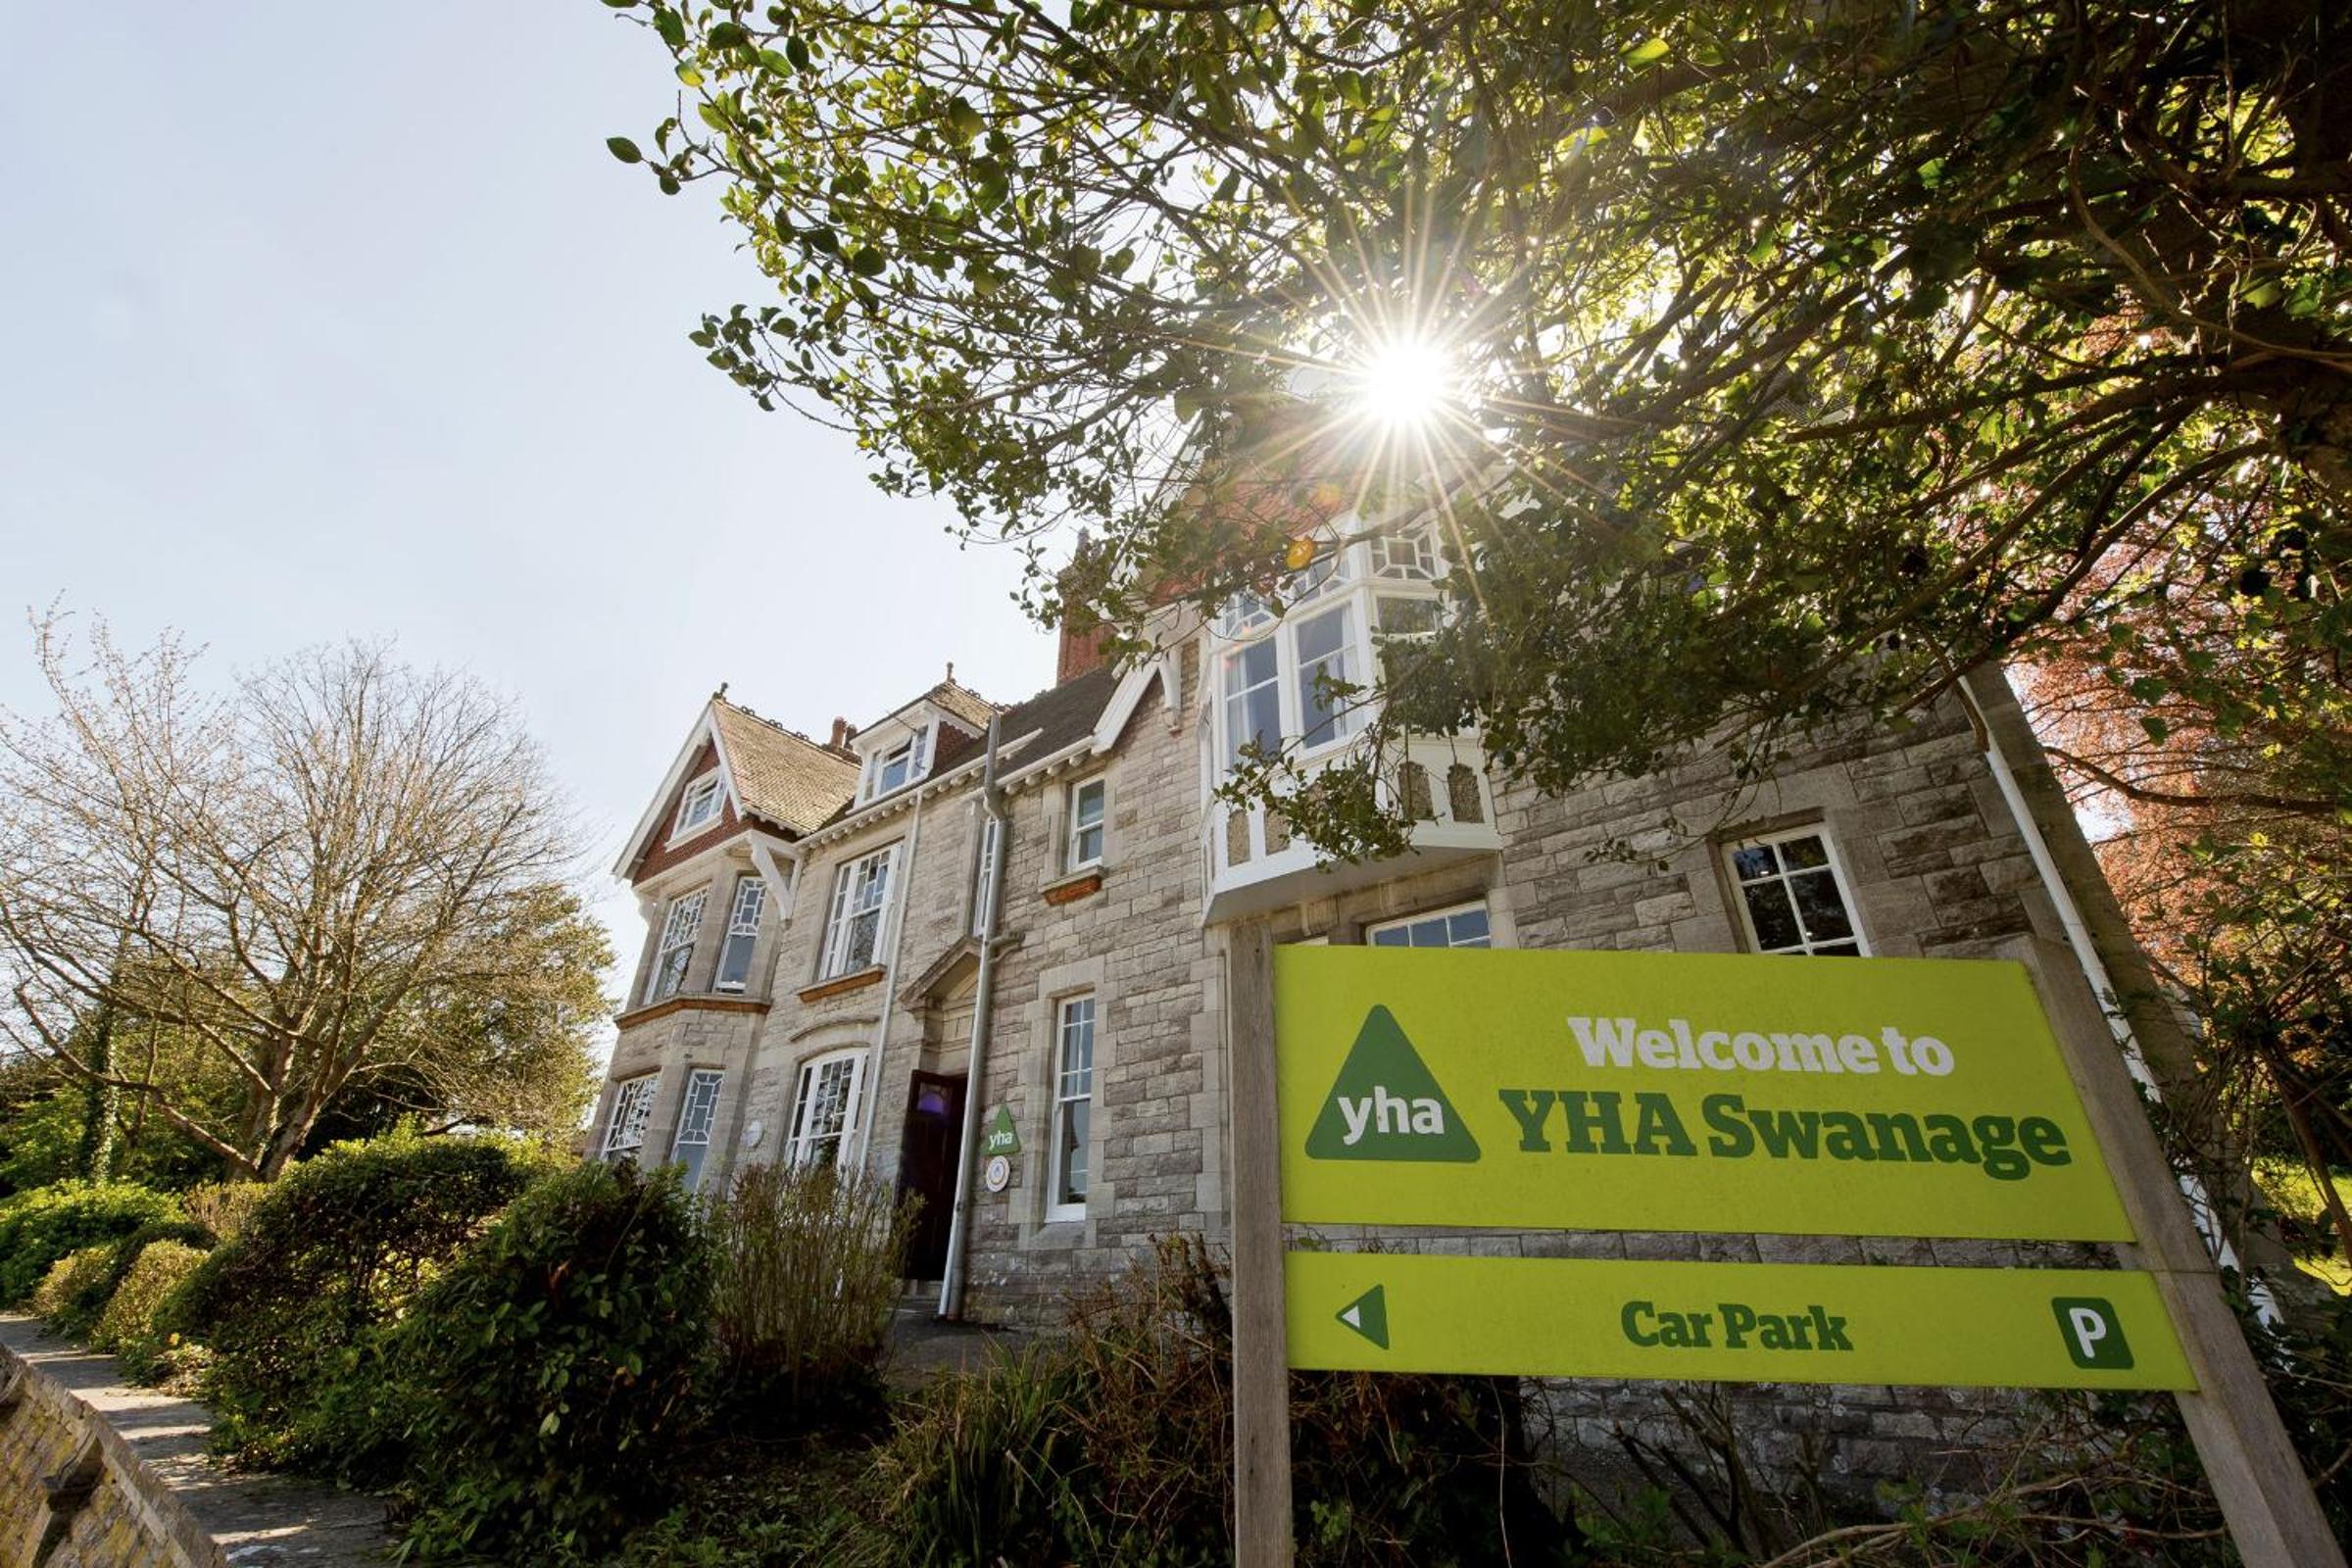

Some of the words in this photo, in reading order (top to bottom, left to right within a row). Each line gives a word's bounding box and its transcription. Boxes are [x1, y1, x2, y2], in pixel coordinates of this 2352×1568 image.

[1567, 1016, 1879, 1073] Welcome
[1882, 1027, 1954, 1076] to
[989, 1129, 1013, 1152] yha
[1338, 1085, 1445, 1146] yha
[1498, 1089, 1697, 1157] YHA
[1701, 1093, 2073, 1182] Swanage
[1621, 1300, 1713, 1348] Car
[1717, 1302, 1855, 1352] Park
[2069, 1307, 2107, 1359] P
